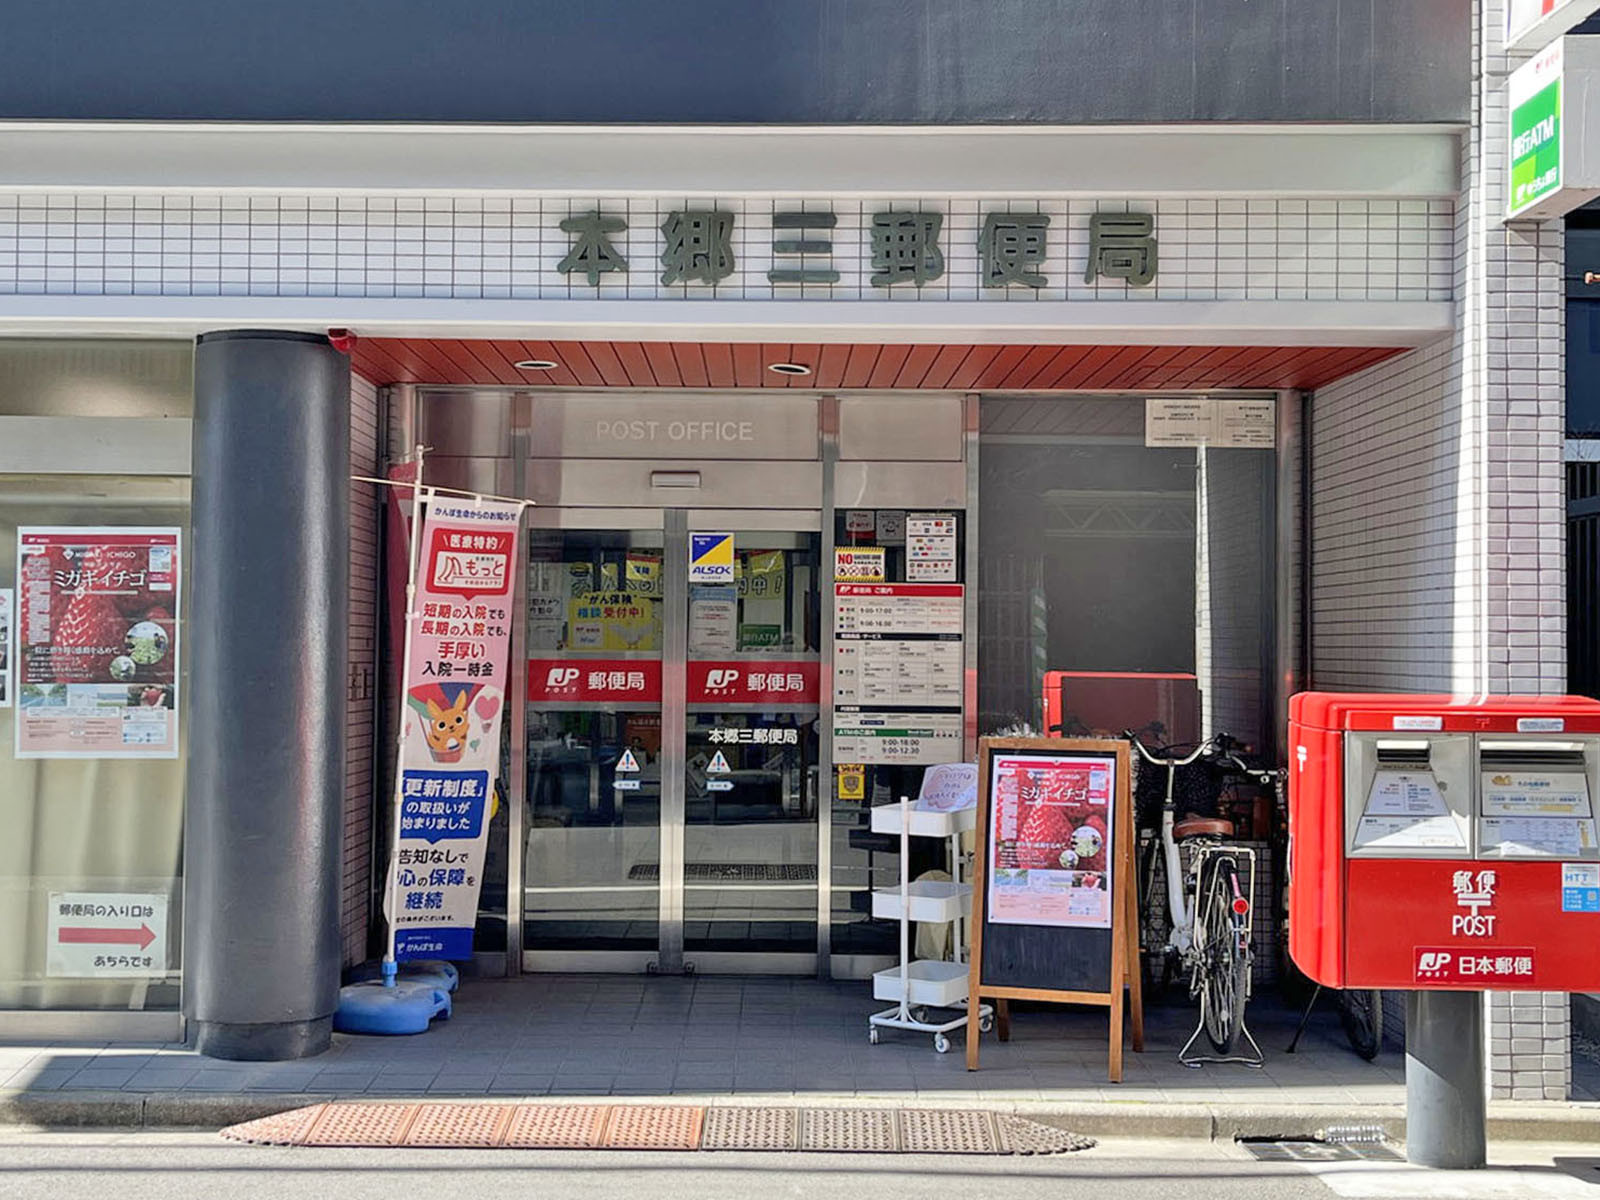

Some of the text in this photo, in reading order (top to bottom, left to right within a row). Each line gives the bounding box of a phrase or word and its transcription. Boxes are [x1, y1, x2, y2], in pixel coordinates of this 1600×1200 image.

[557, 210, 1159, 288] 本郷三郵便局
[596, 420, 754, 441] POST OFFICE
[434, 507, 517, 521] かんぽ生命からのお知らせ
[450, 534, 499, 550] 医療特約
[838, 554, 853, 565] NO
[466, 560, 504, 577] もっと
[692, 566, 731, 575] ALSOK
[53, 569, 147, 587] ミガキイチゴ
[423, 603, 506, 621] 短期の入院でも
[421, 621, 507, 637] 長期の入院でも、
[438, 642, 486, 660] 手厚い
[422, 662, 494, 678] 入院一時金
[588, 671, 645, 691] 郵便局
[747, 673, 805, 692] 郵便局
[708, 728, 798, 745] 本郷三郵便局
[403, 777, 484, 798] 更新制度」
[406, 801, 472, 815] の取扱いが
[402, 816, 471, 830] 始まりました
[399, 848, 469, 865] 告知なしで
[397, 868, 476, 887] 心の保障を
[1453, 870, 1495, 894] 郵便
[1564, 873, 1589, 882] HTT
[405, 891, 445, 910] 継続
[59, 904, 154, 918] 郵便局の入り口は
[1451, 915, 1496, 936] POST
[94, 956, 153, 968] あちらです
[1459, 957, 1533, 975] 日本郵便
